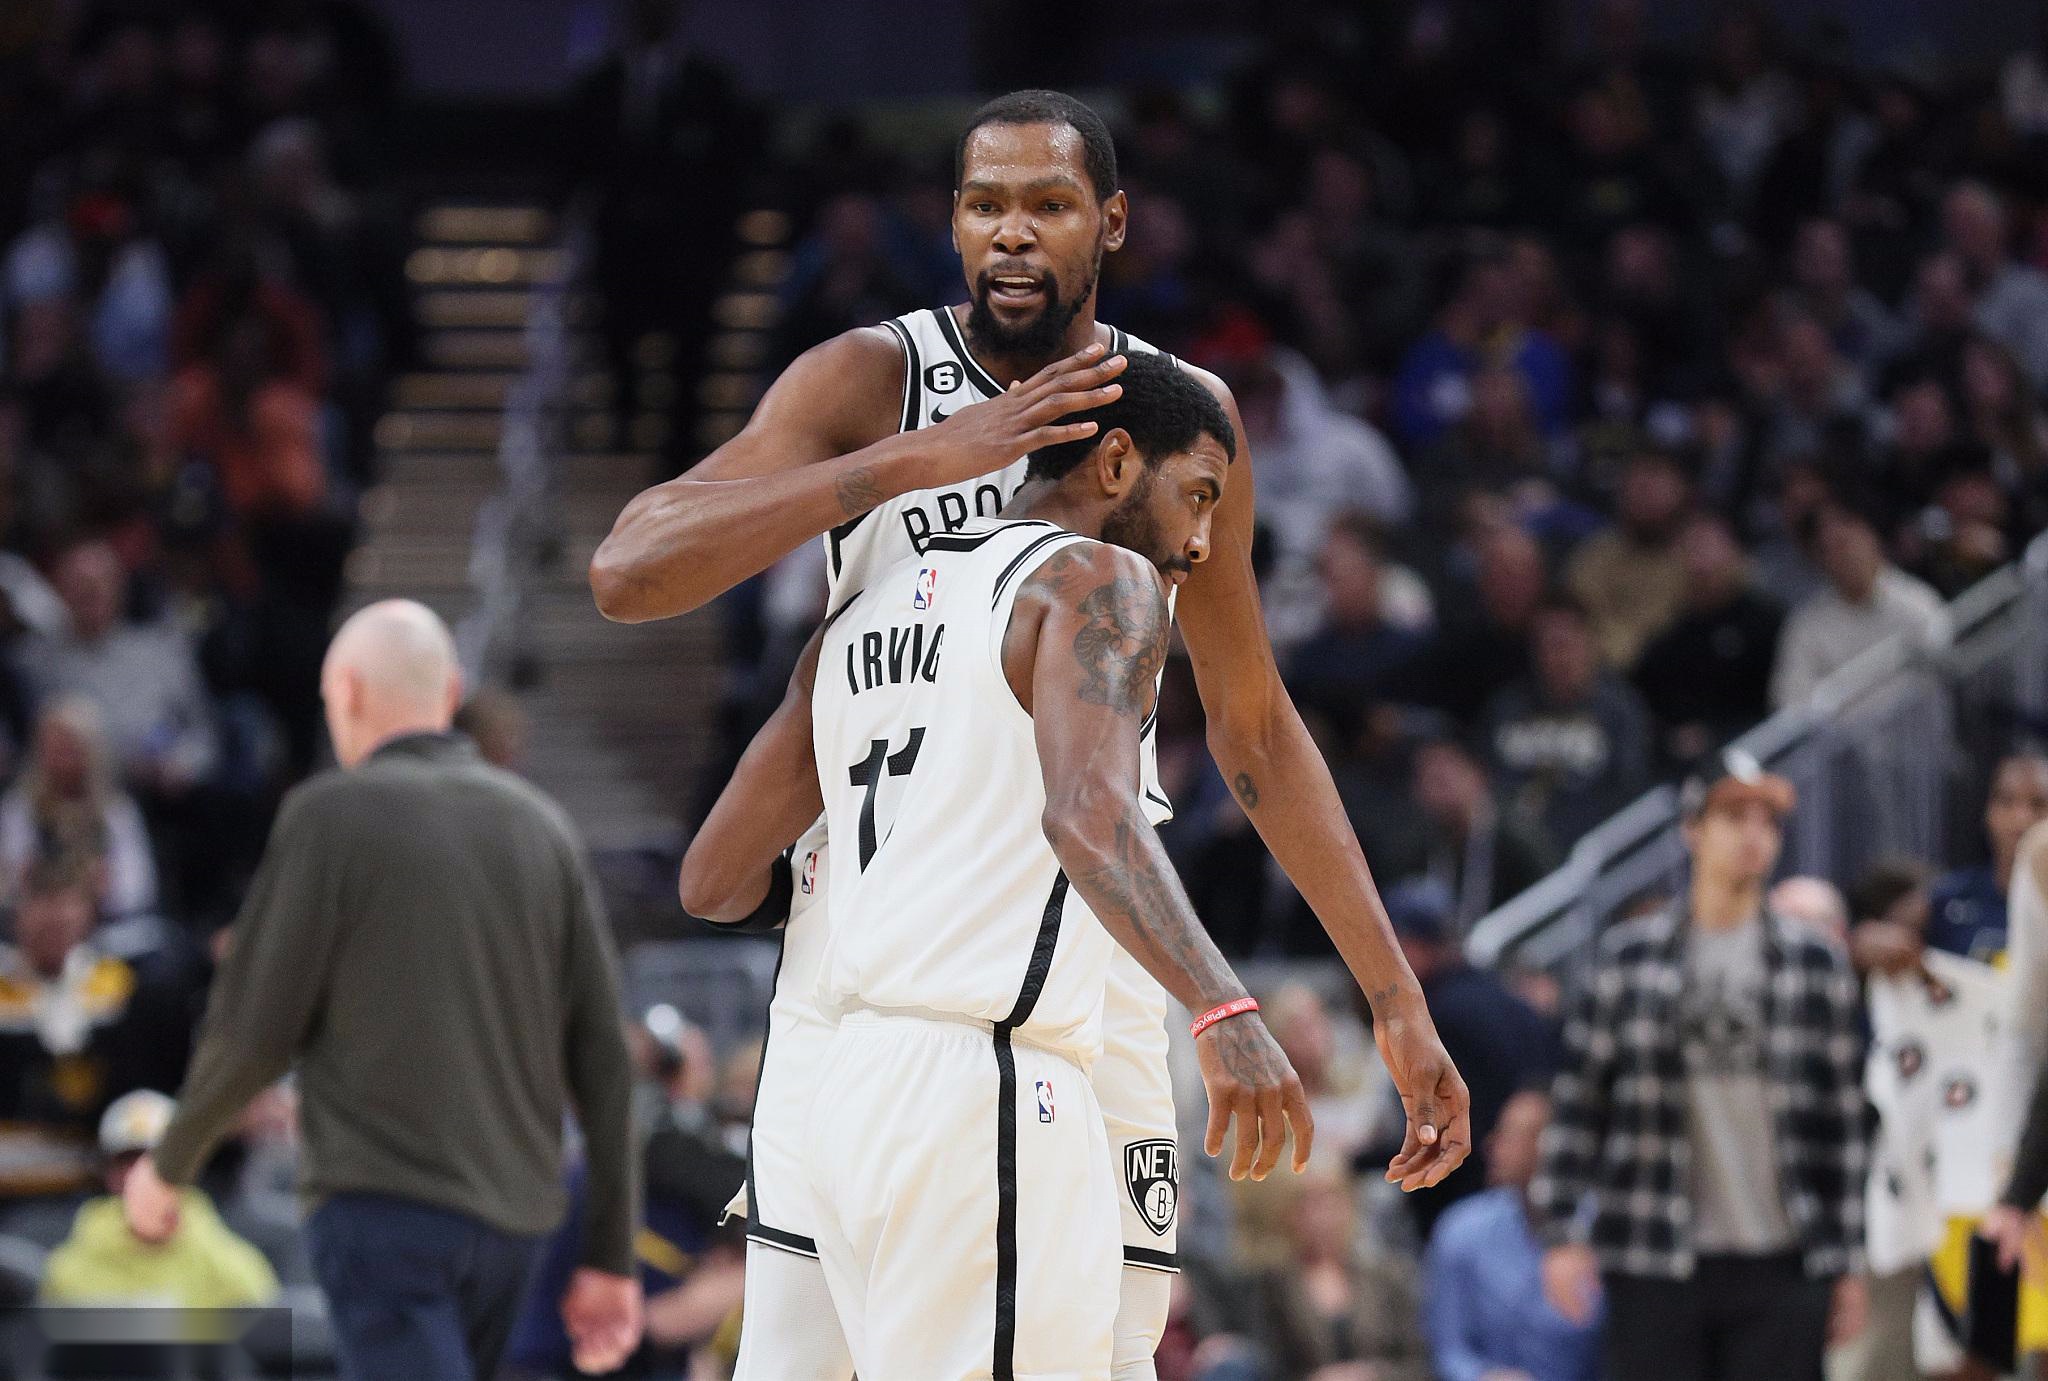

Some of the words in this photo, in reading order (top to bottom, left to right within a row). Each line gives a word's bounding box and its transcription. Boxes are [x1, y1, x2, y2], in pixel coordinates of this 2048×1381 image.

[932, 364, 956, 392] 6
[902, 484, 1026, 558] BRO
[1156, 1187, 1167, 1219] B
